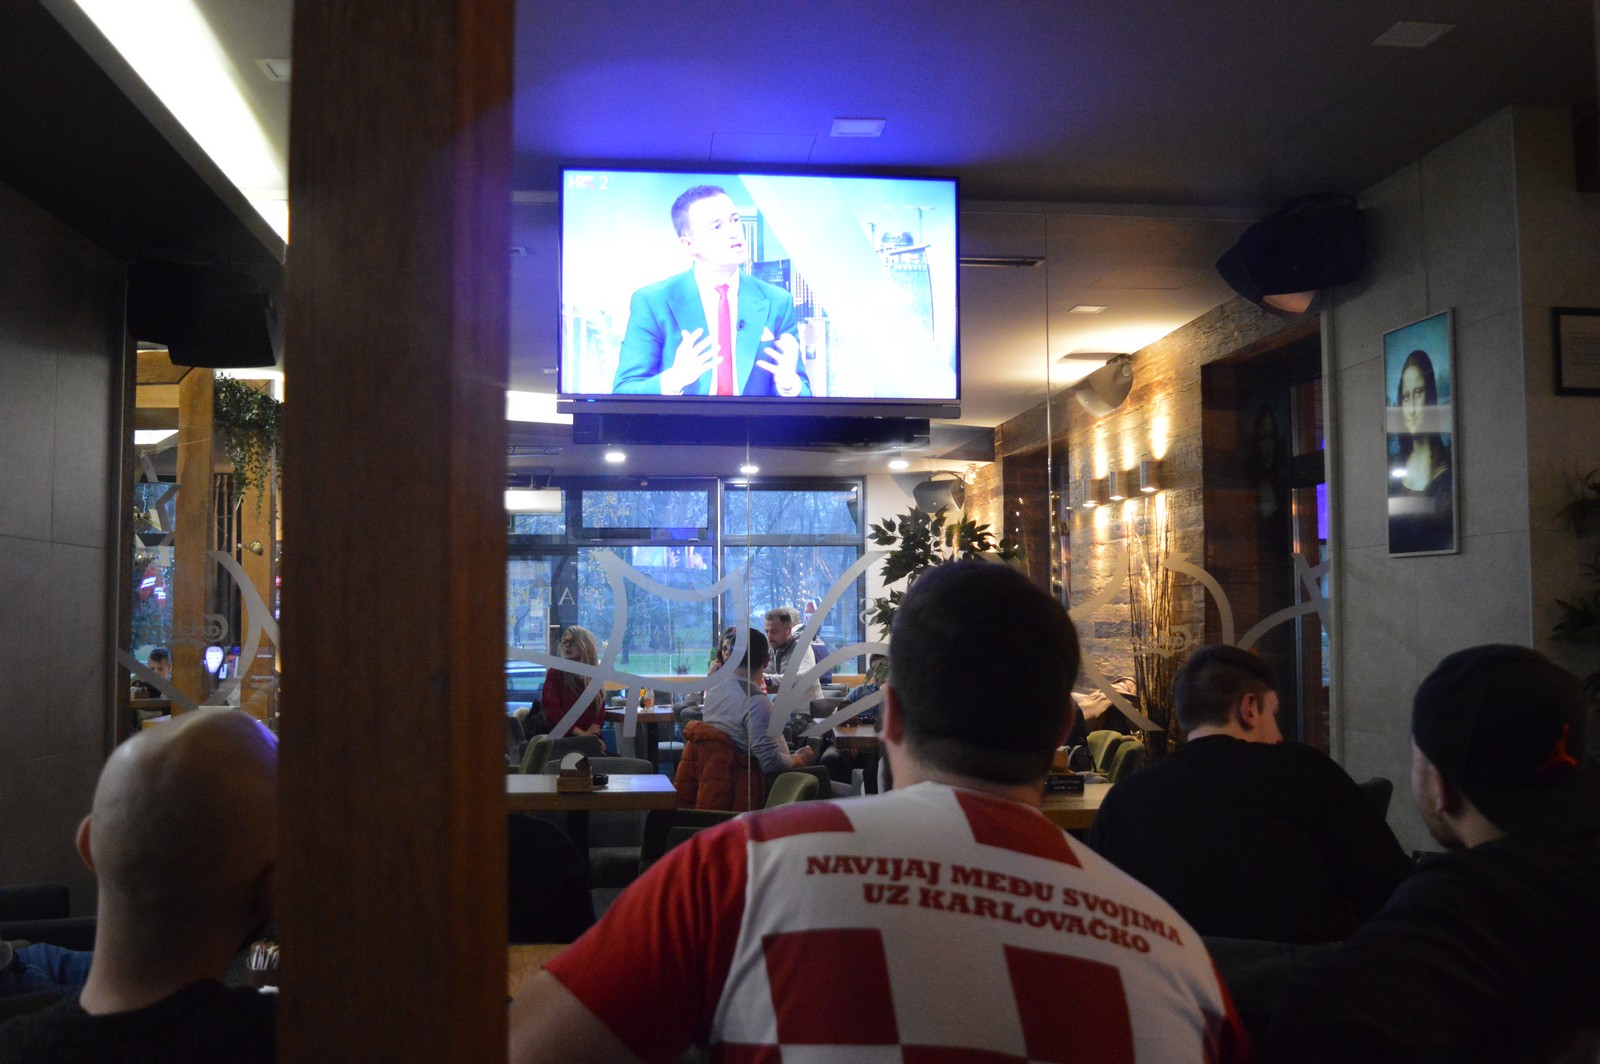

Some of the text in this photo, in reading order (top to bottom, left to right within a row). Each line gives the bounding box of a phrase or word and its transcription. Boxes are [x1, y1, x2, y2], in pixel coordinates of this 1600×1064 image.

[599, 175, 609, 191] 2
[806, 855, 1184, 946] NAVIJAJ MEĐU SVOJIMA
[863, 883, 1151, 954] UZ KARLOVAČKO
